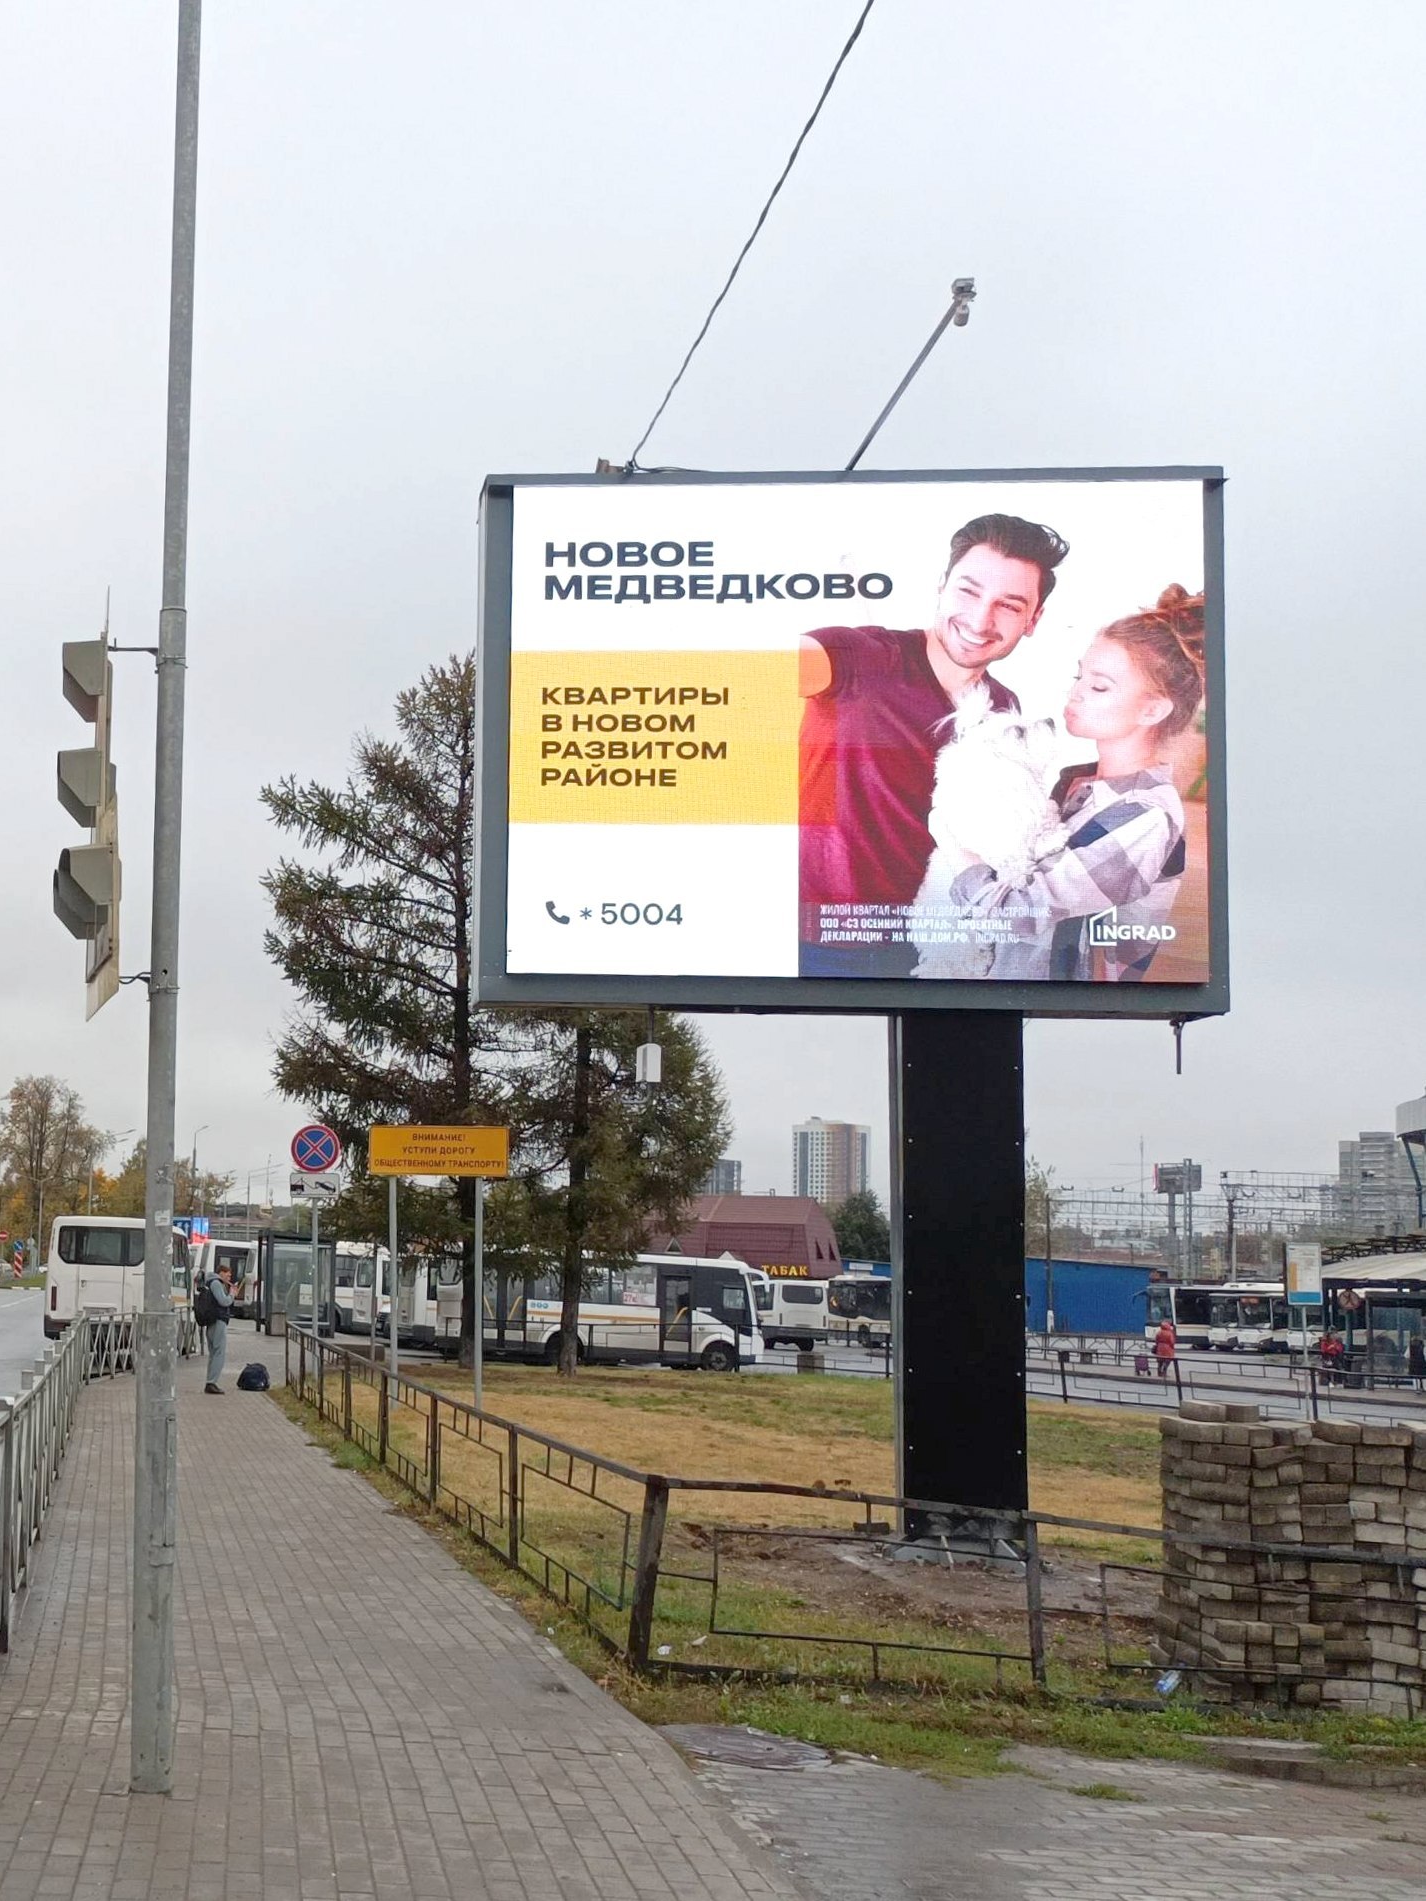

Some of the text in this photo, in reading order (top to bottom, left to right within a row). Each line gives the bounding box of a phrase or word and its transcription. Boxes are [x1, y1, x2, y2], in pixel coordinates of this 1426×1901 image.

[545, 541, 714, 567] НОВОЕ
[545, 573, 893, 603] МЕДВЕДКОВО
[542, 687, 729, 705] КВАРТИРЫ
[541, 714, 695, 732] В НОВОМ
[541, 741, 728, 759] РАЗВИТОМ
[541, 763, 677, 786] РАЙОНЕ
[820, 903, 851, 916] ЖИЛОЙ
[853, 905, 890, 916] КВАРТАЛ
[820, 918, 839, 929] ООО
[860, 917, 903, 930] ОСЕННИЙ
[957, 919, 1013, 931] ПРОЕКТНЫЕ
[820, 931, 883, 943] ДЕКЛАРАЦИИ
[891, 932, 905, 942] НА
[1096, 924, 1176, 940] INGRAD
[412, 1133, 466, 1142] ВНИМАНИЕ!
[402, 1146, 475, 1155] УСТУПИ ДОРОГУ
[374, 1158, 505, 1169] ОБЩЕСТВЕННОМУ ТРАНСПОРТУ!
[761, 1264, 809, 1277] ТАБАК
